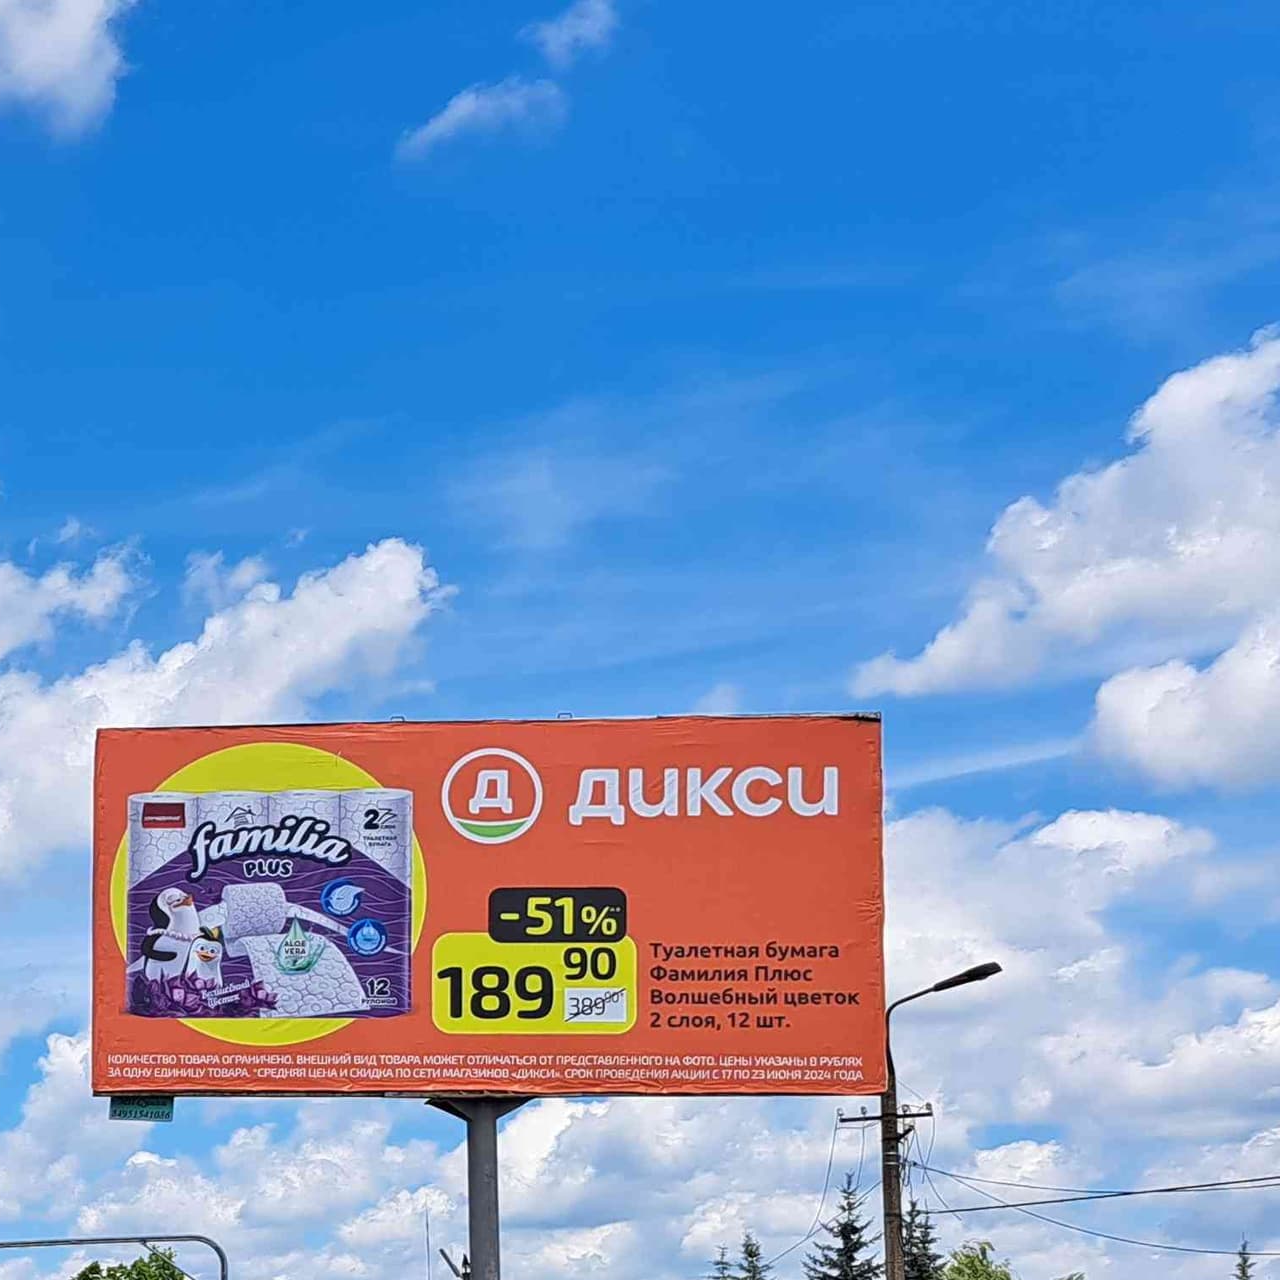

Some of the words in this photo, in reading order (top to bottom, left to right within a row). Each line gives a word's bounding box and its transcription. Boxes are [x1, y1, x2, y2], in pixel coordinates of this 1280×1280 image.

[363, 809, 379, 829] 2
[189, 816, 352, 880] familia
[244, 859, 293, 876] PLUS
[650, 942, 759, 961] Туалетная
[766, 941, 840, 961] бумага
[650, 965, 748, 983] Фамилия
[754, 967, 813, 983] Плюс
[368, 978, 390, 996] 12
[437, 965, 554, 1019] 189
[563, 948, 617, 981] 90
[569, 997, 605, 1015] 389
[650, 988, 780, 1006] Волшебный
[784, 991, 860, 1008] цветок
[650, 1013, 661, 1028] 2
[667, 1014, 721, 1031] слоя,
[729, 1013, 751, 1028] 12
[756, 1014, 791, 1028] шт.
[107, 1054, 177, 1065] КОЛИЧЕСТВО
[179, 1054, 220, 1065] ТОВАРА
[296, 1052, 351, 1065] ВНЕШНИЙ
[354, 1055, 377, 1066] ВИД
[380, 1055, 421, 1065] ТОВАРА
[423, 1055, 465, 1065] МОЖЕТ
[466, 1055, 537, 1066] ОТЛИЧАТЬСЯ
[539, 1055, 553, 1065] ОТ
[556, 1055, 663, 1067] ПРЕДСТАВЛЕННОГО
[665, 1056, 681, 1066] НА
[719, 1056, 752, 1068] ЦЕНЫ
[754, 1056, 807, 1067] УКАЗАНЫ
[819, 1056, 863, 1067] РУБЛЯХ
[107, 1067, 121, 1078] ЗА
[123, 1067, 152, 1079] ОДНУ
[154, 1067, 206, 1079] ЕДИНИЦУ
[308, 1068, 338, 1079] ЦЕНА
[339, 1068, 348, 1078] И
[349, 1068, 393, 1079] СКИДКА
[395, 1068, 411, 1078] ПО
[413, 1068, 441, 1078] СЕТИ
[443, 1068, 509, 1079] МАГАЗИНОВ
[564, 1069, 593, 1079] СРОК
[595, 1069, 669, 1080] ПРОВЕДЕНИЯ
[671, 1069, 710, 1081] АКЦИИ
[712, 1069, 720, 1080] С
[721, 1069, 732, 1080] 17
[734, 1069, 750, 1080] ПО
[751, 1069, 765, 1080] 23
[767, 1069, 801, 1080] ИЮНЯ
[804, 1070, 831, 1080] 2024
[833, 1070, 864, 1081] ГОДА
